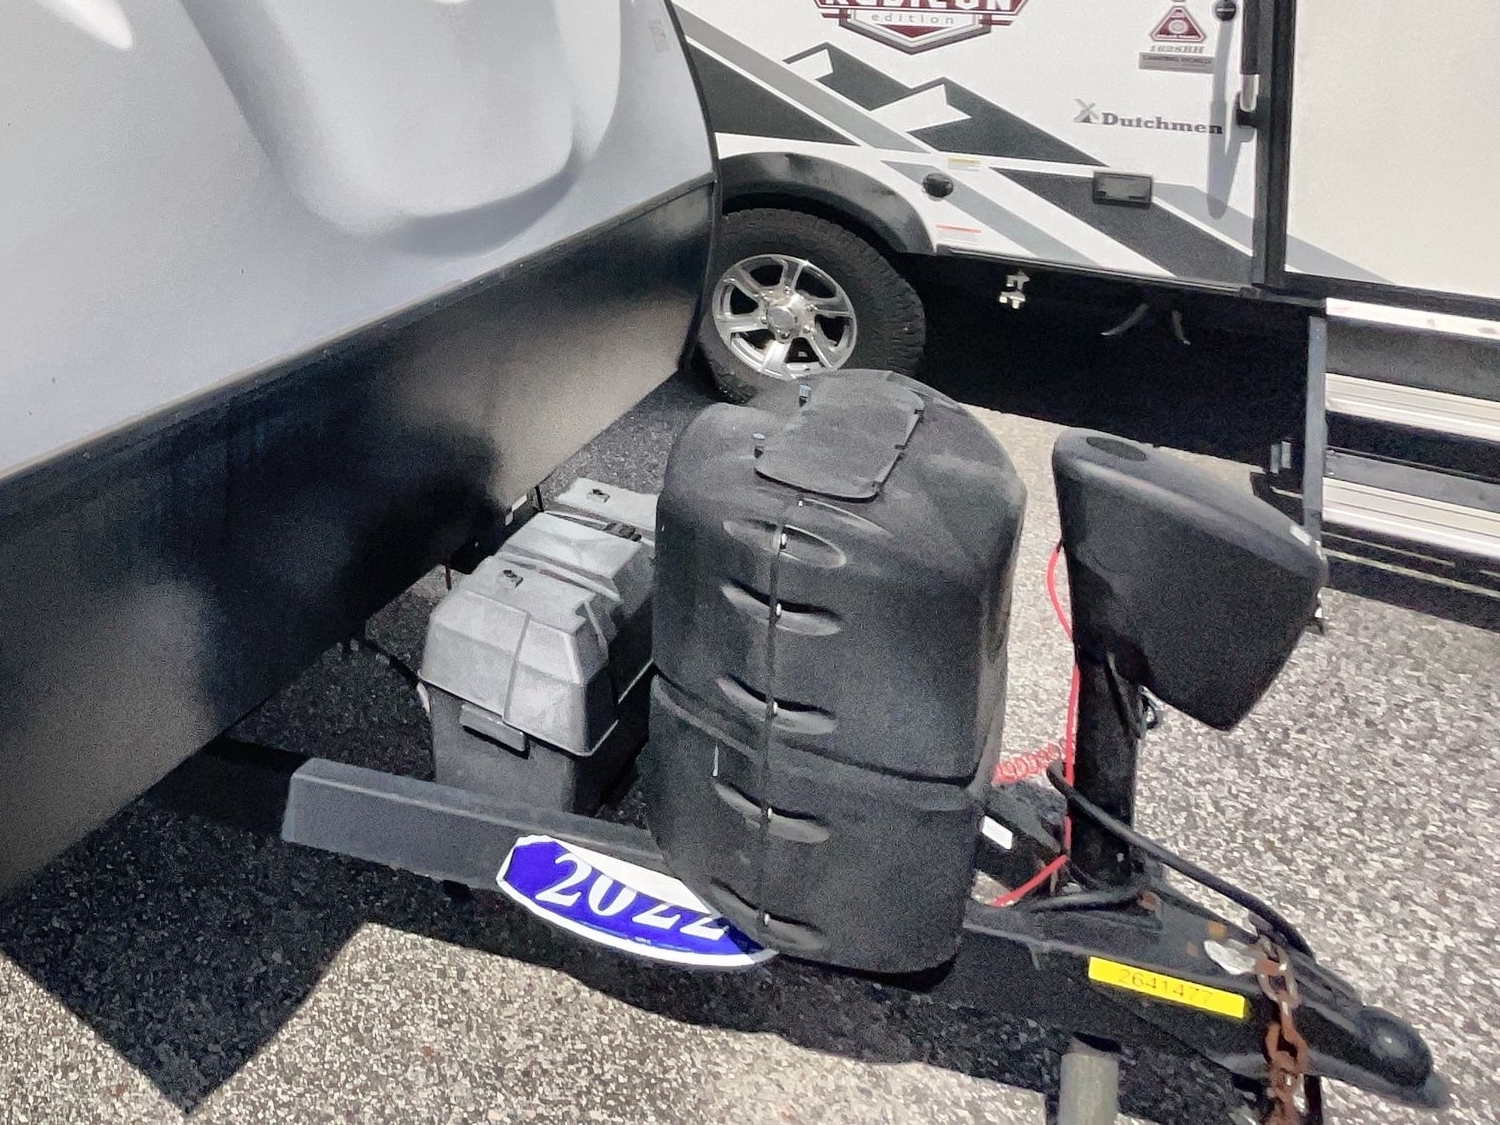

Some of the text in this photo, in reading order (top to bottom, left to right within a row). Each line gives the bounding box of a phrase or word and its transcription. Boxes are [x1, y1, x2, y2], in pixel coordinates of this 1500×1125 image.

[871, 13, 955, 24] edition
[1102, 112, 1223, 134] Dutchmen
[1118, 968, 1214, 1005] 2641477
